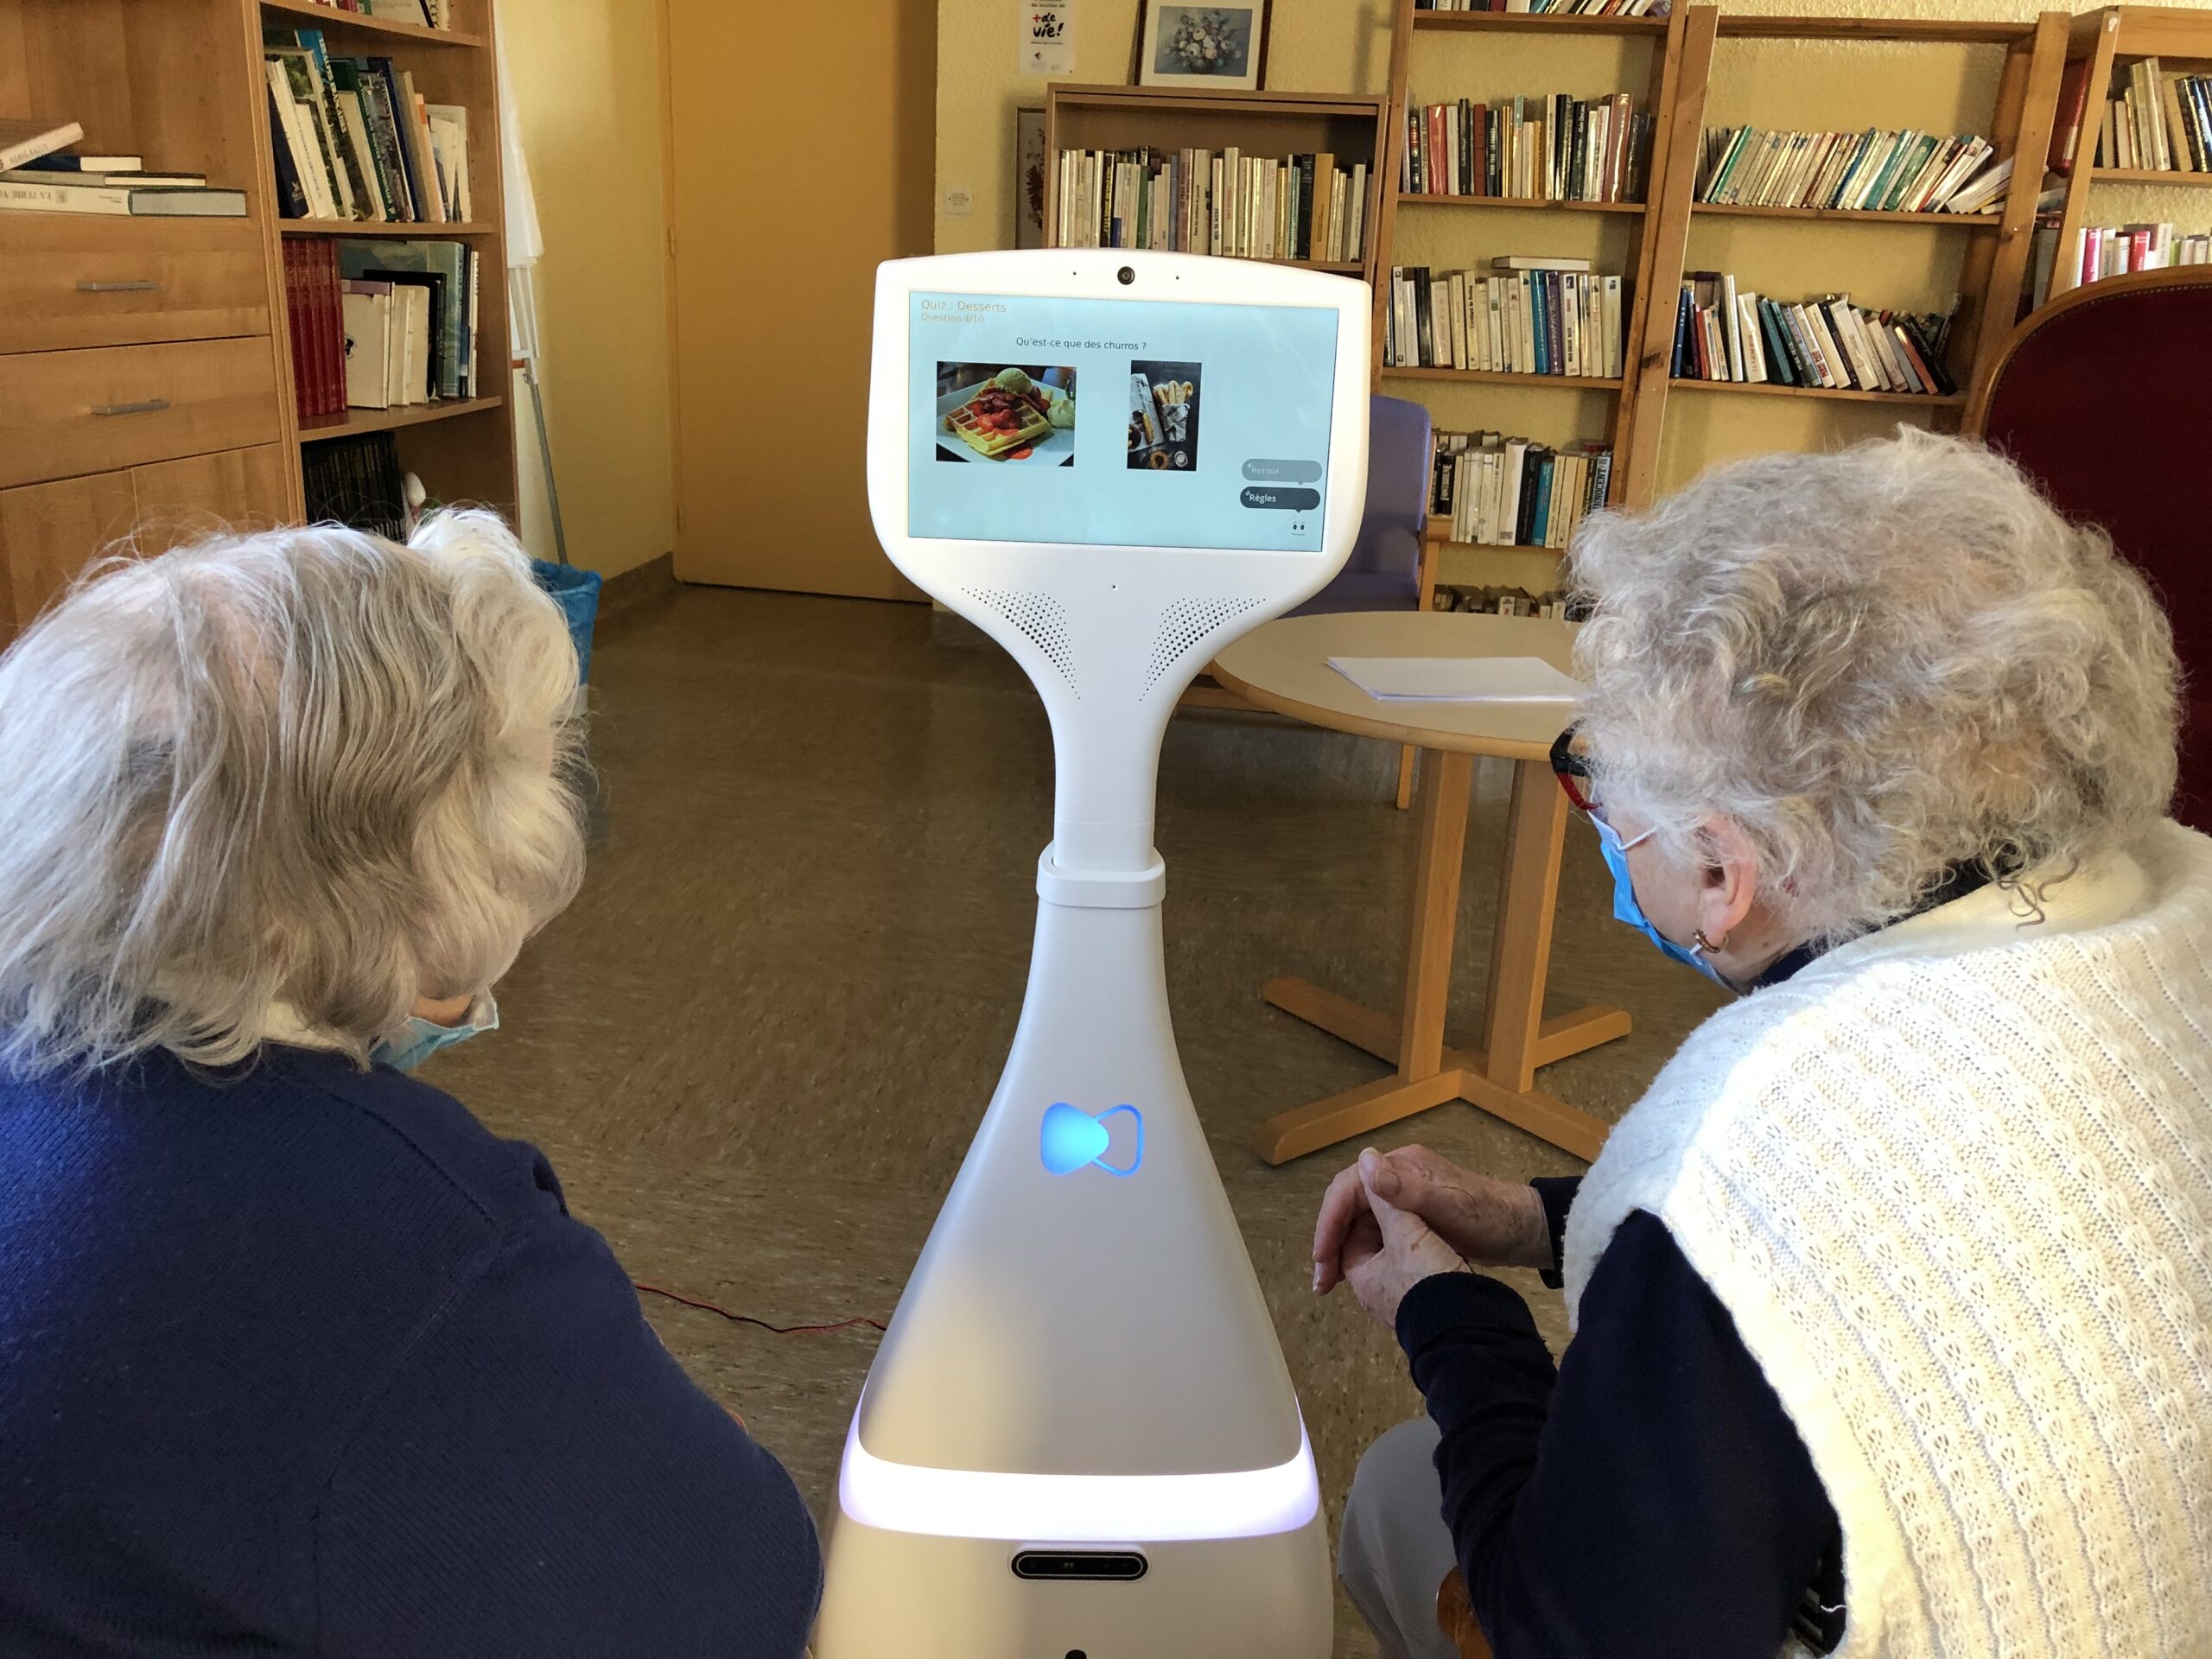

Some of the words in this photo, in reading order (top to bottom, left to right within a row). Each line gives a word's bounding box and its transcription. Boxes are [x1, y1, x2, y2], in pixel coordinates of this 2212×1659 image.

[1033, 22, 1065, 38] vie!
[921, 299, 946, 310] Quiz
[957, 301, 1007, 312] Desserts
[921, 312, 962, 322] Question
[1064, 340, 1082, 348] que
[1084, 340, 1101, 349] des
[1103, 340, 1139, 350] churros
[1251, 467, 1280, 475] Retour
[1249, 493, 1276, 505] Règles
